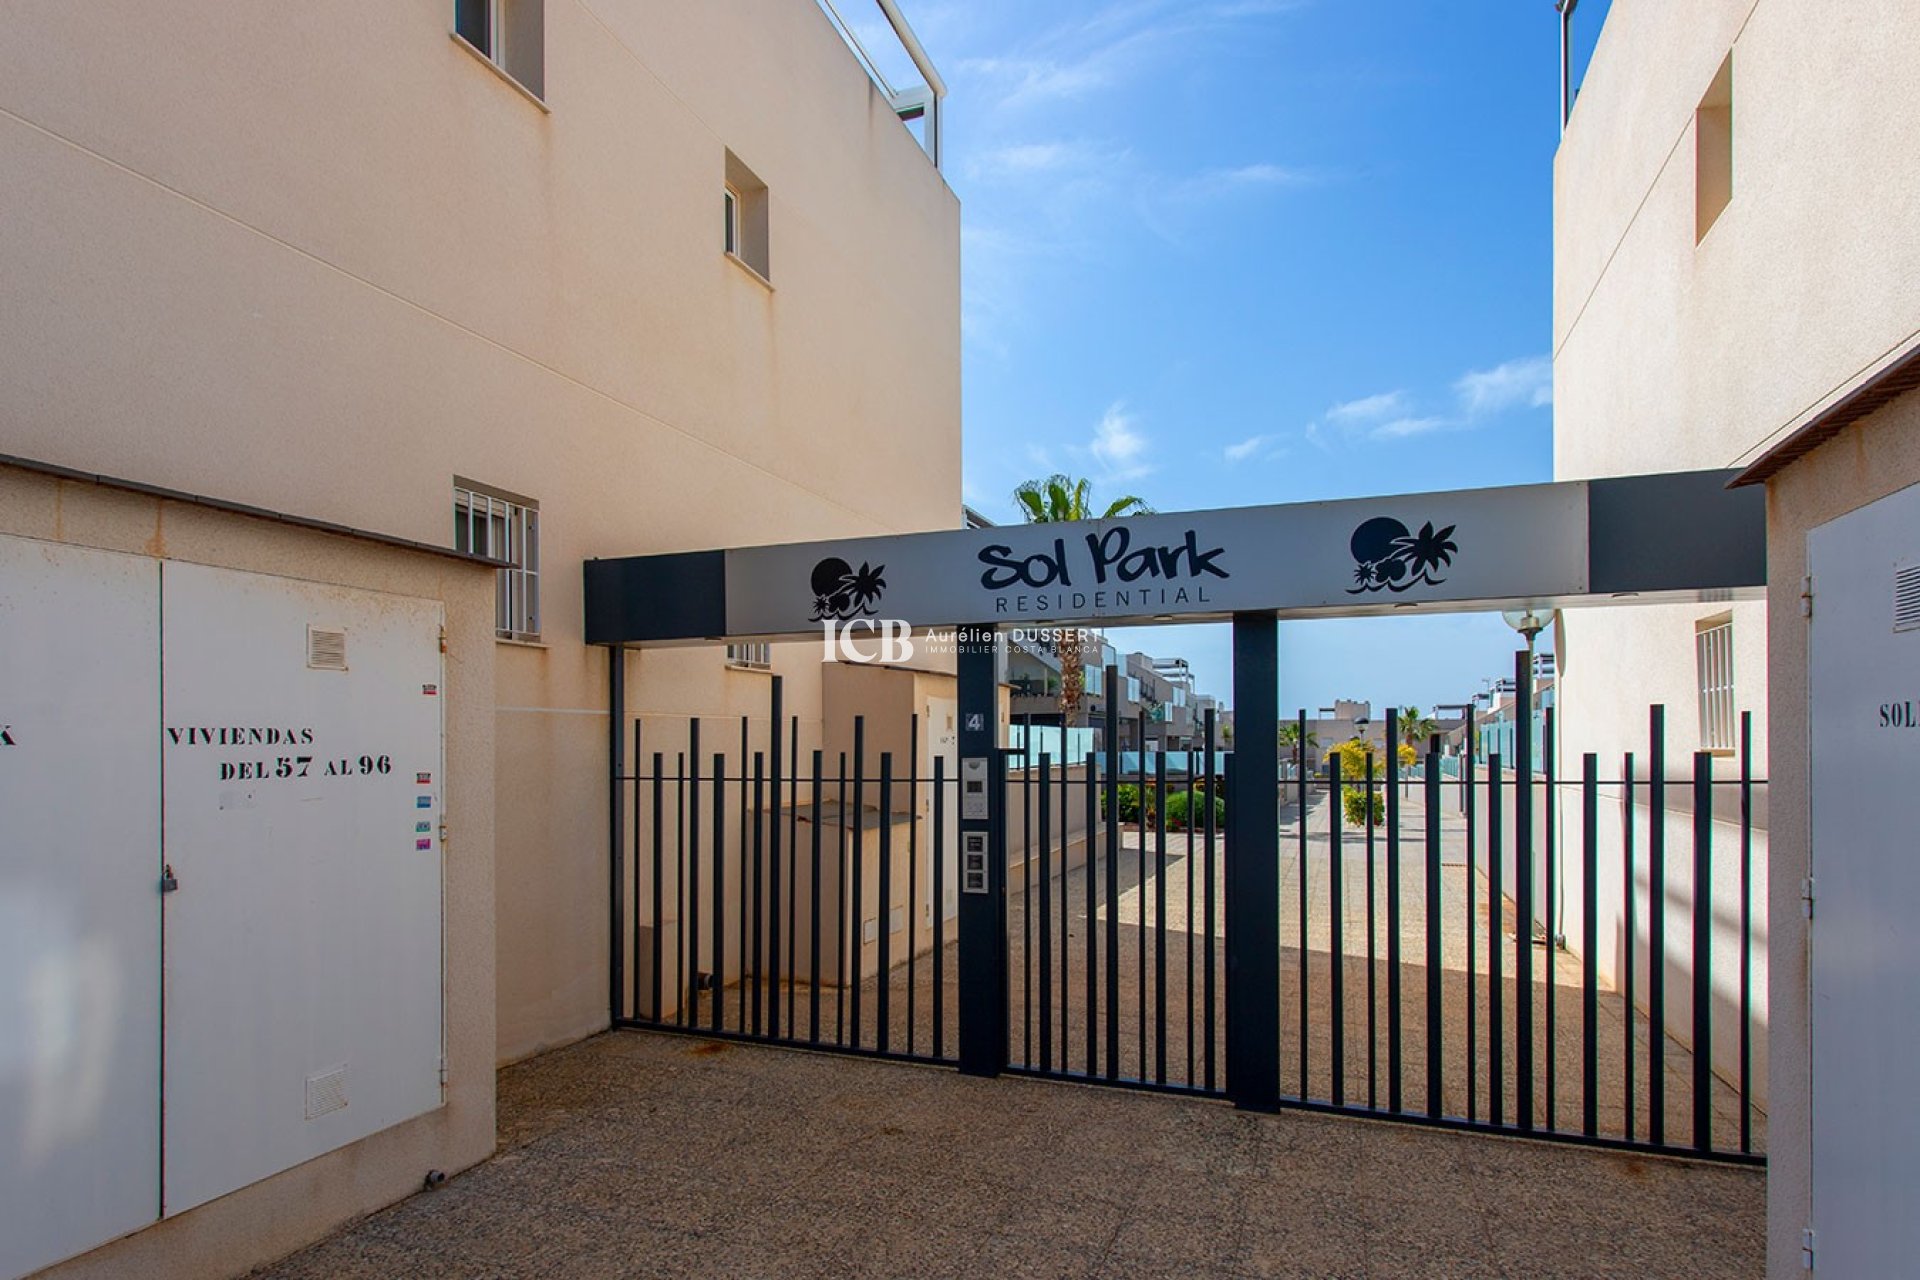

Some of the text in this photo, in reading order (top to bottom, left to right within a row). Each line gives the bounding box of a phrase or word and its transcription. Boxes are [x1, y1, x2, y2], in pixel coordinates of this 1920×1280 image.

[978, 526, 1230, 590] Sol Park
[996, 586, 1210, 613] RESIDENTIAL
[967, 713, 981, 731] 4
[167, 727, 314, 745] VIVIENDAS
[220, 755, 392, 780] DEL 57 AL 96
